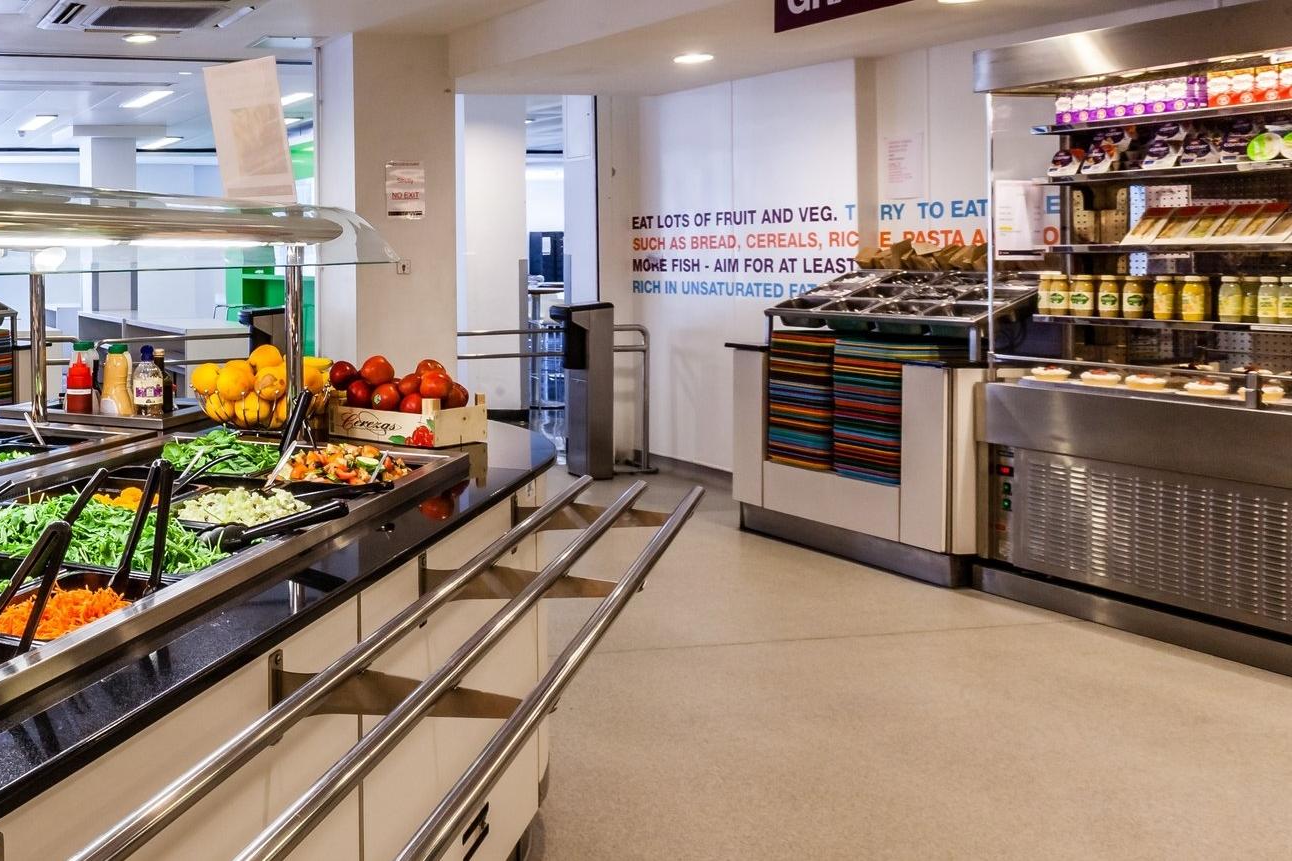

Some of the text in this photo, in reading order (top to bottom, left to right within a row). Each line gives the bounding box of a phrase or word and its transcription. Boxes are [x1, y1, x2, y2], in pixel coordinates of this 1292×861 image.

[392, 192, 419, 200] NO EXIT
[632, 216, 653, 229] EAT
[657, 214, 690, 228] LOTS
[694, 212, 711, 227] OF
[716, 210, 756, 226] FRUIT
[761, 209, 793, 224] AND
[799, 206, 837, 222] VEG.
[917, 201, 944, 219] TO
[951, 199, 988, 217] EAT
[633, 237, 665, 251] SUCH
[670, 236, 686, 249] AS
[691, 235, 740, 251] BREAD,
[746, 232, 822, 250] CEREALS,
[633, 259, 667, 272] MORE
[671, 259, 700, 272] FISH
[714, 259, 739, 272] AIM
[744, 258, 774, 273] FOR
[779, 258, 797, 273] AT
[803, 258, 855, 273] LEAST
[633, 281, 661, 294] RICH
[665, 281, 677, 294] IN
[682, 281, 784, 298] UNSATURATED
